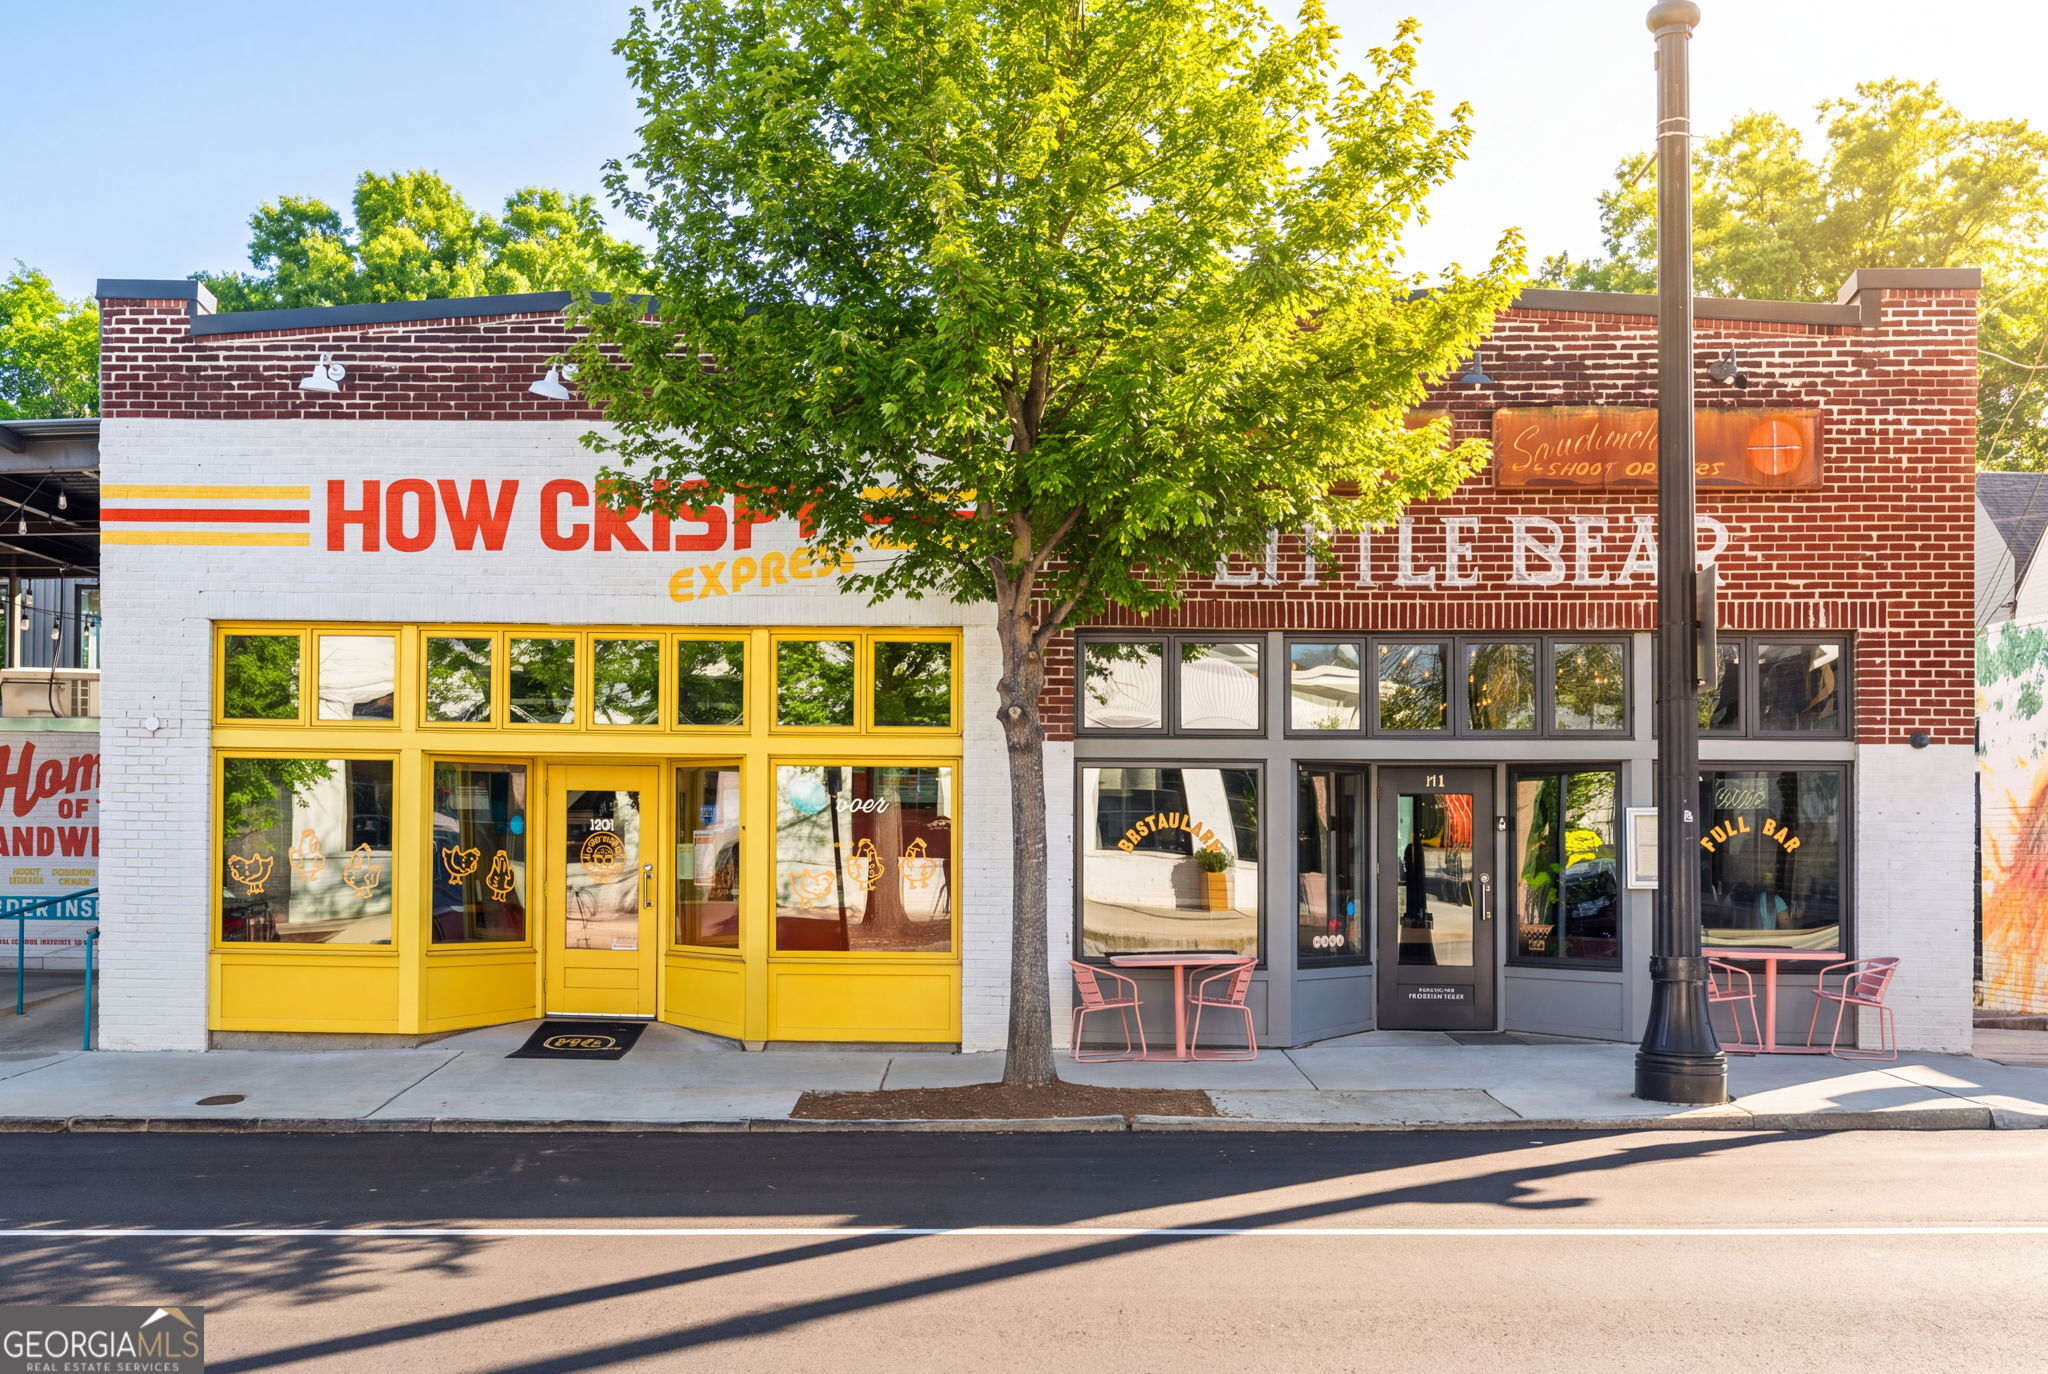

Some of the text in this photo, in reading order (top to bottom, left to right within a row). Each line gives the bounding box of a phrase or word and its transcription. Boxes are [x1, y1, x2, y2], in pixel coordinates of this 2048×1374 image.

[327, 479, 519, 552] HOW
[58, 798, 89, 819] OF
[1700, 816, 1801, 853] FULL BAR
